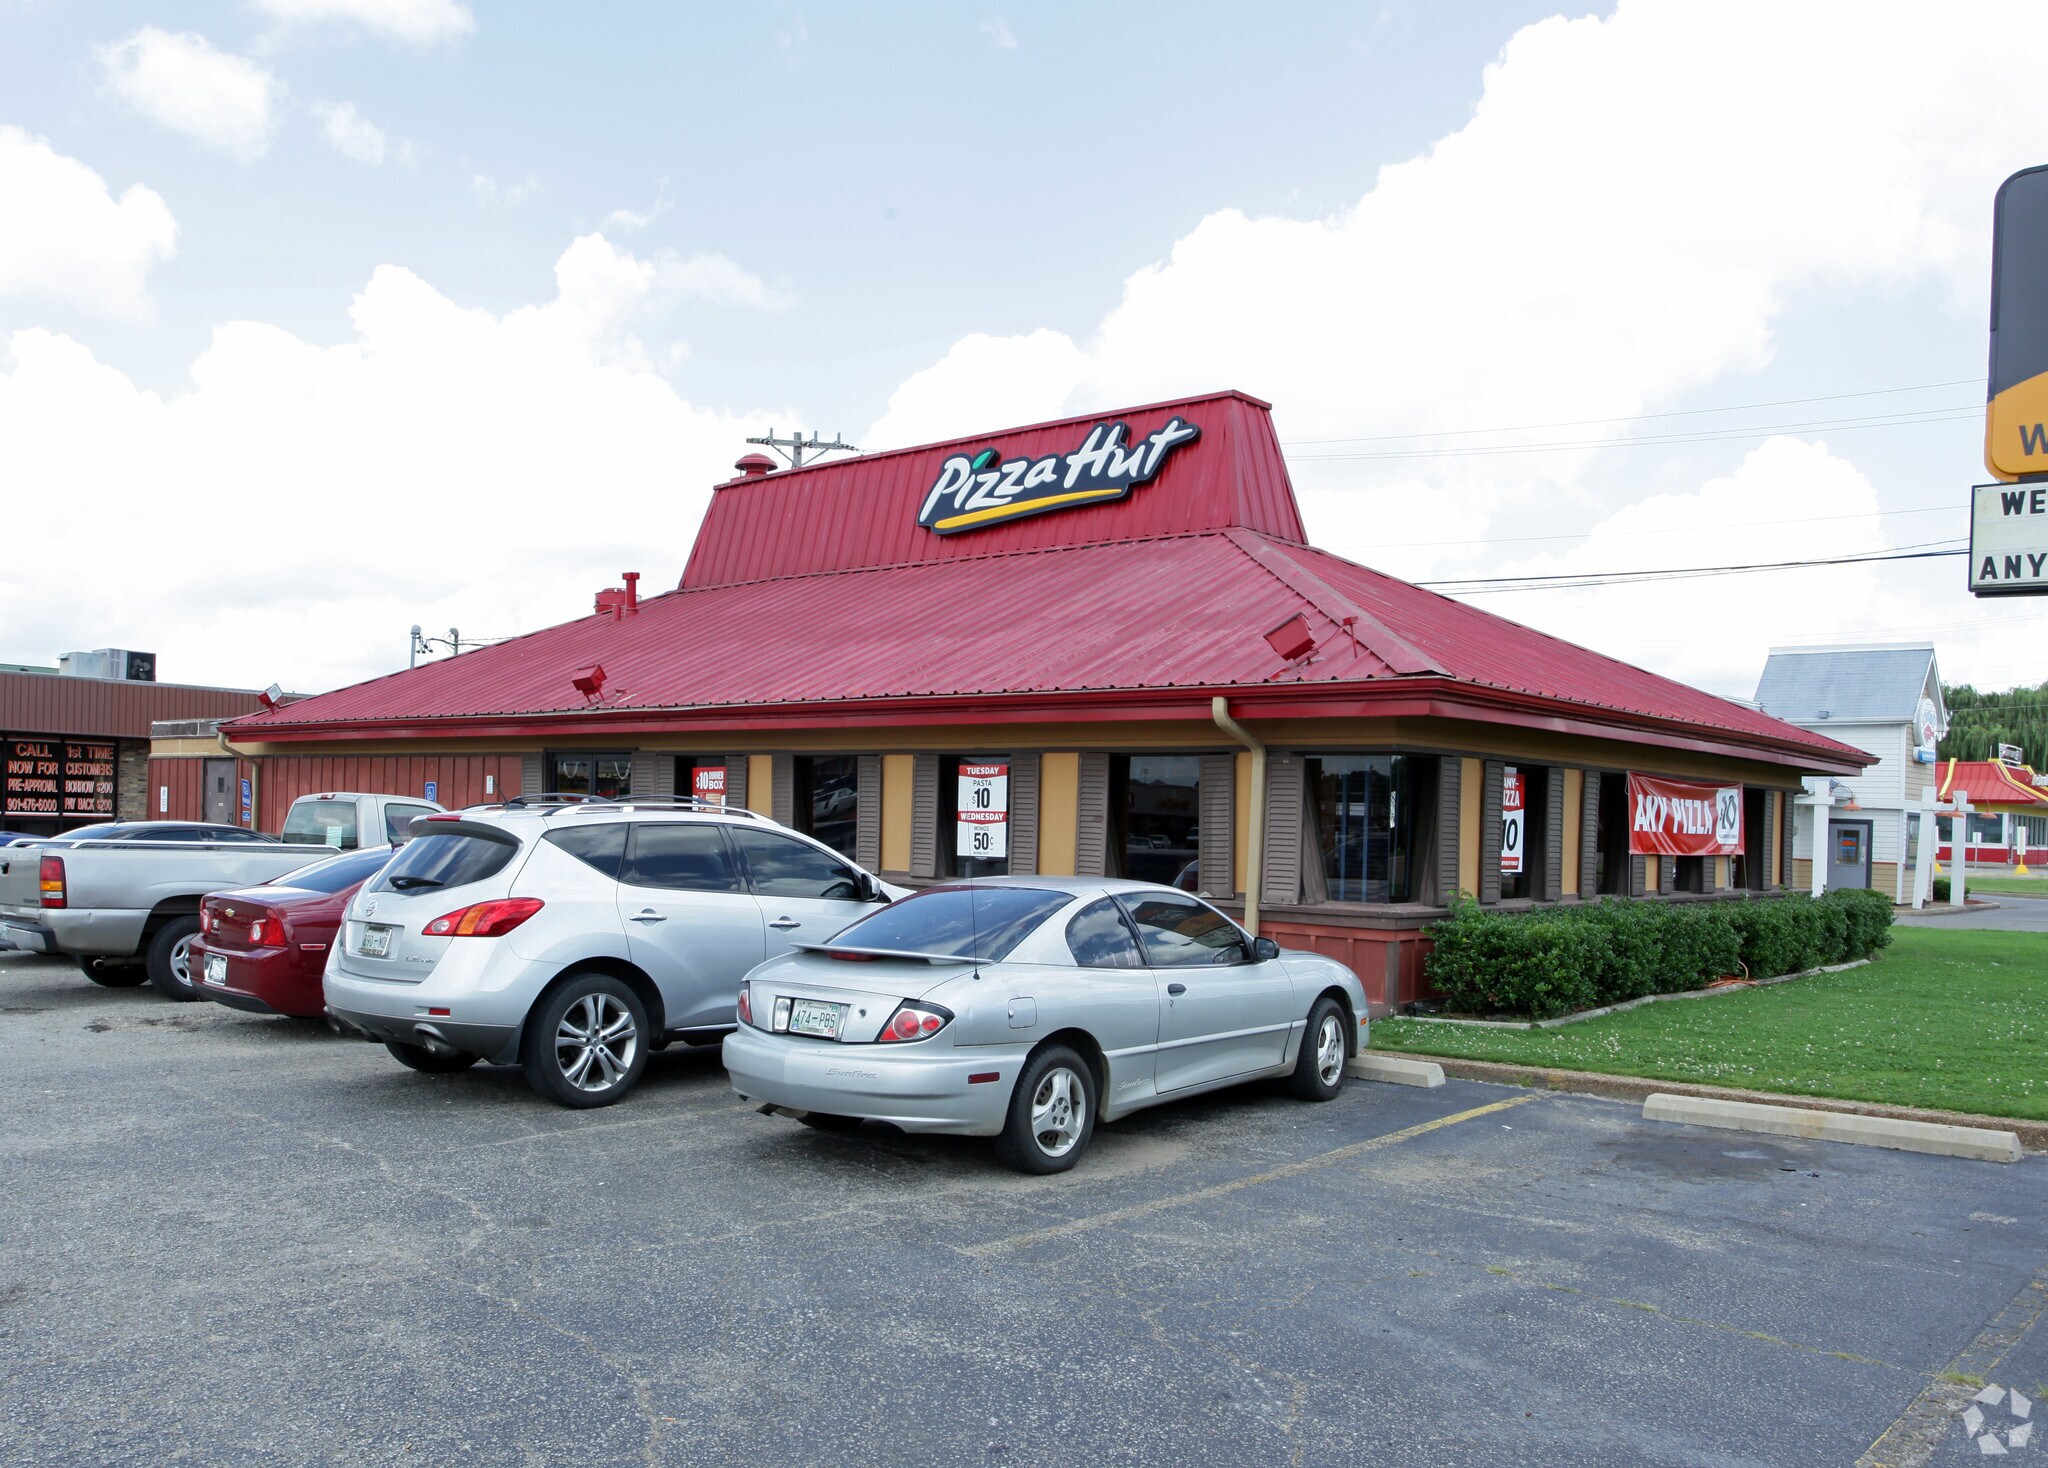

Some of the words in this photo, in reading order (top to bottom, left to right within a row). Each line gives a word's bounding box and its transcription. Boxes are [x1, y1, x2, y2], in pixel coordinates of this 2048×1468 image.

[918, 451, 1057, 523] Pizza
[1063, 420, 1193, 489] Hut
[1979, 553, 2047, 580] ANY
[15, 743, 52, 758] CALL
[66, 745, 82, 759] 1st
[86, 746, 114, 760] TIME
[8, 761, 34, 774] NOW
[37, 761, 59, 775] FOR
[65, 762, 114, 776] CUSTOMERS
[709, 771, 724, 779] DINNER
[966, 766, 1000, 775] TUESDAY
[8, 778, 58, 793] PRE-APPROVAL
[65, 780, 94, 793] BORROW
[96, 781, 114, 794] $200
[696, 771, 709, 790] $10
[709, 780, 724, 790] BOX
[7, 797, 58, 812] 901-476-6000
[64, 797, 76, 810] PAY
[77, 798, 95, 811] BACK
[96, 799, 113, 812] $200
[971, 787, 990, 809] $10
[1503, 790, 1520, 806] IZZA
[960, 812, 1004, 821] WEDNESDAY
[1634, 794, 1668, 832] ANY
[1671, 798, 1713, 835] PIZZA
[1719, 795, 1737, 830] $10
[973, 832, 994, 850] 50¢
[805, 1002, 828, 1010] Tennessee
[794, 1010, 836, 1028] 474-PBS
